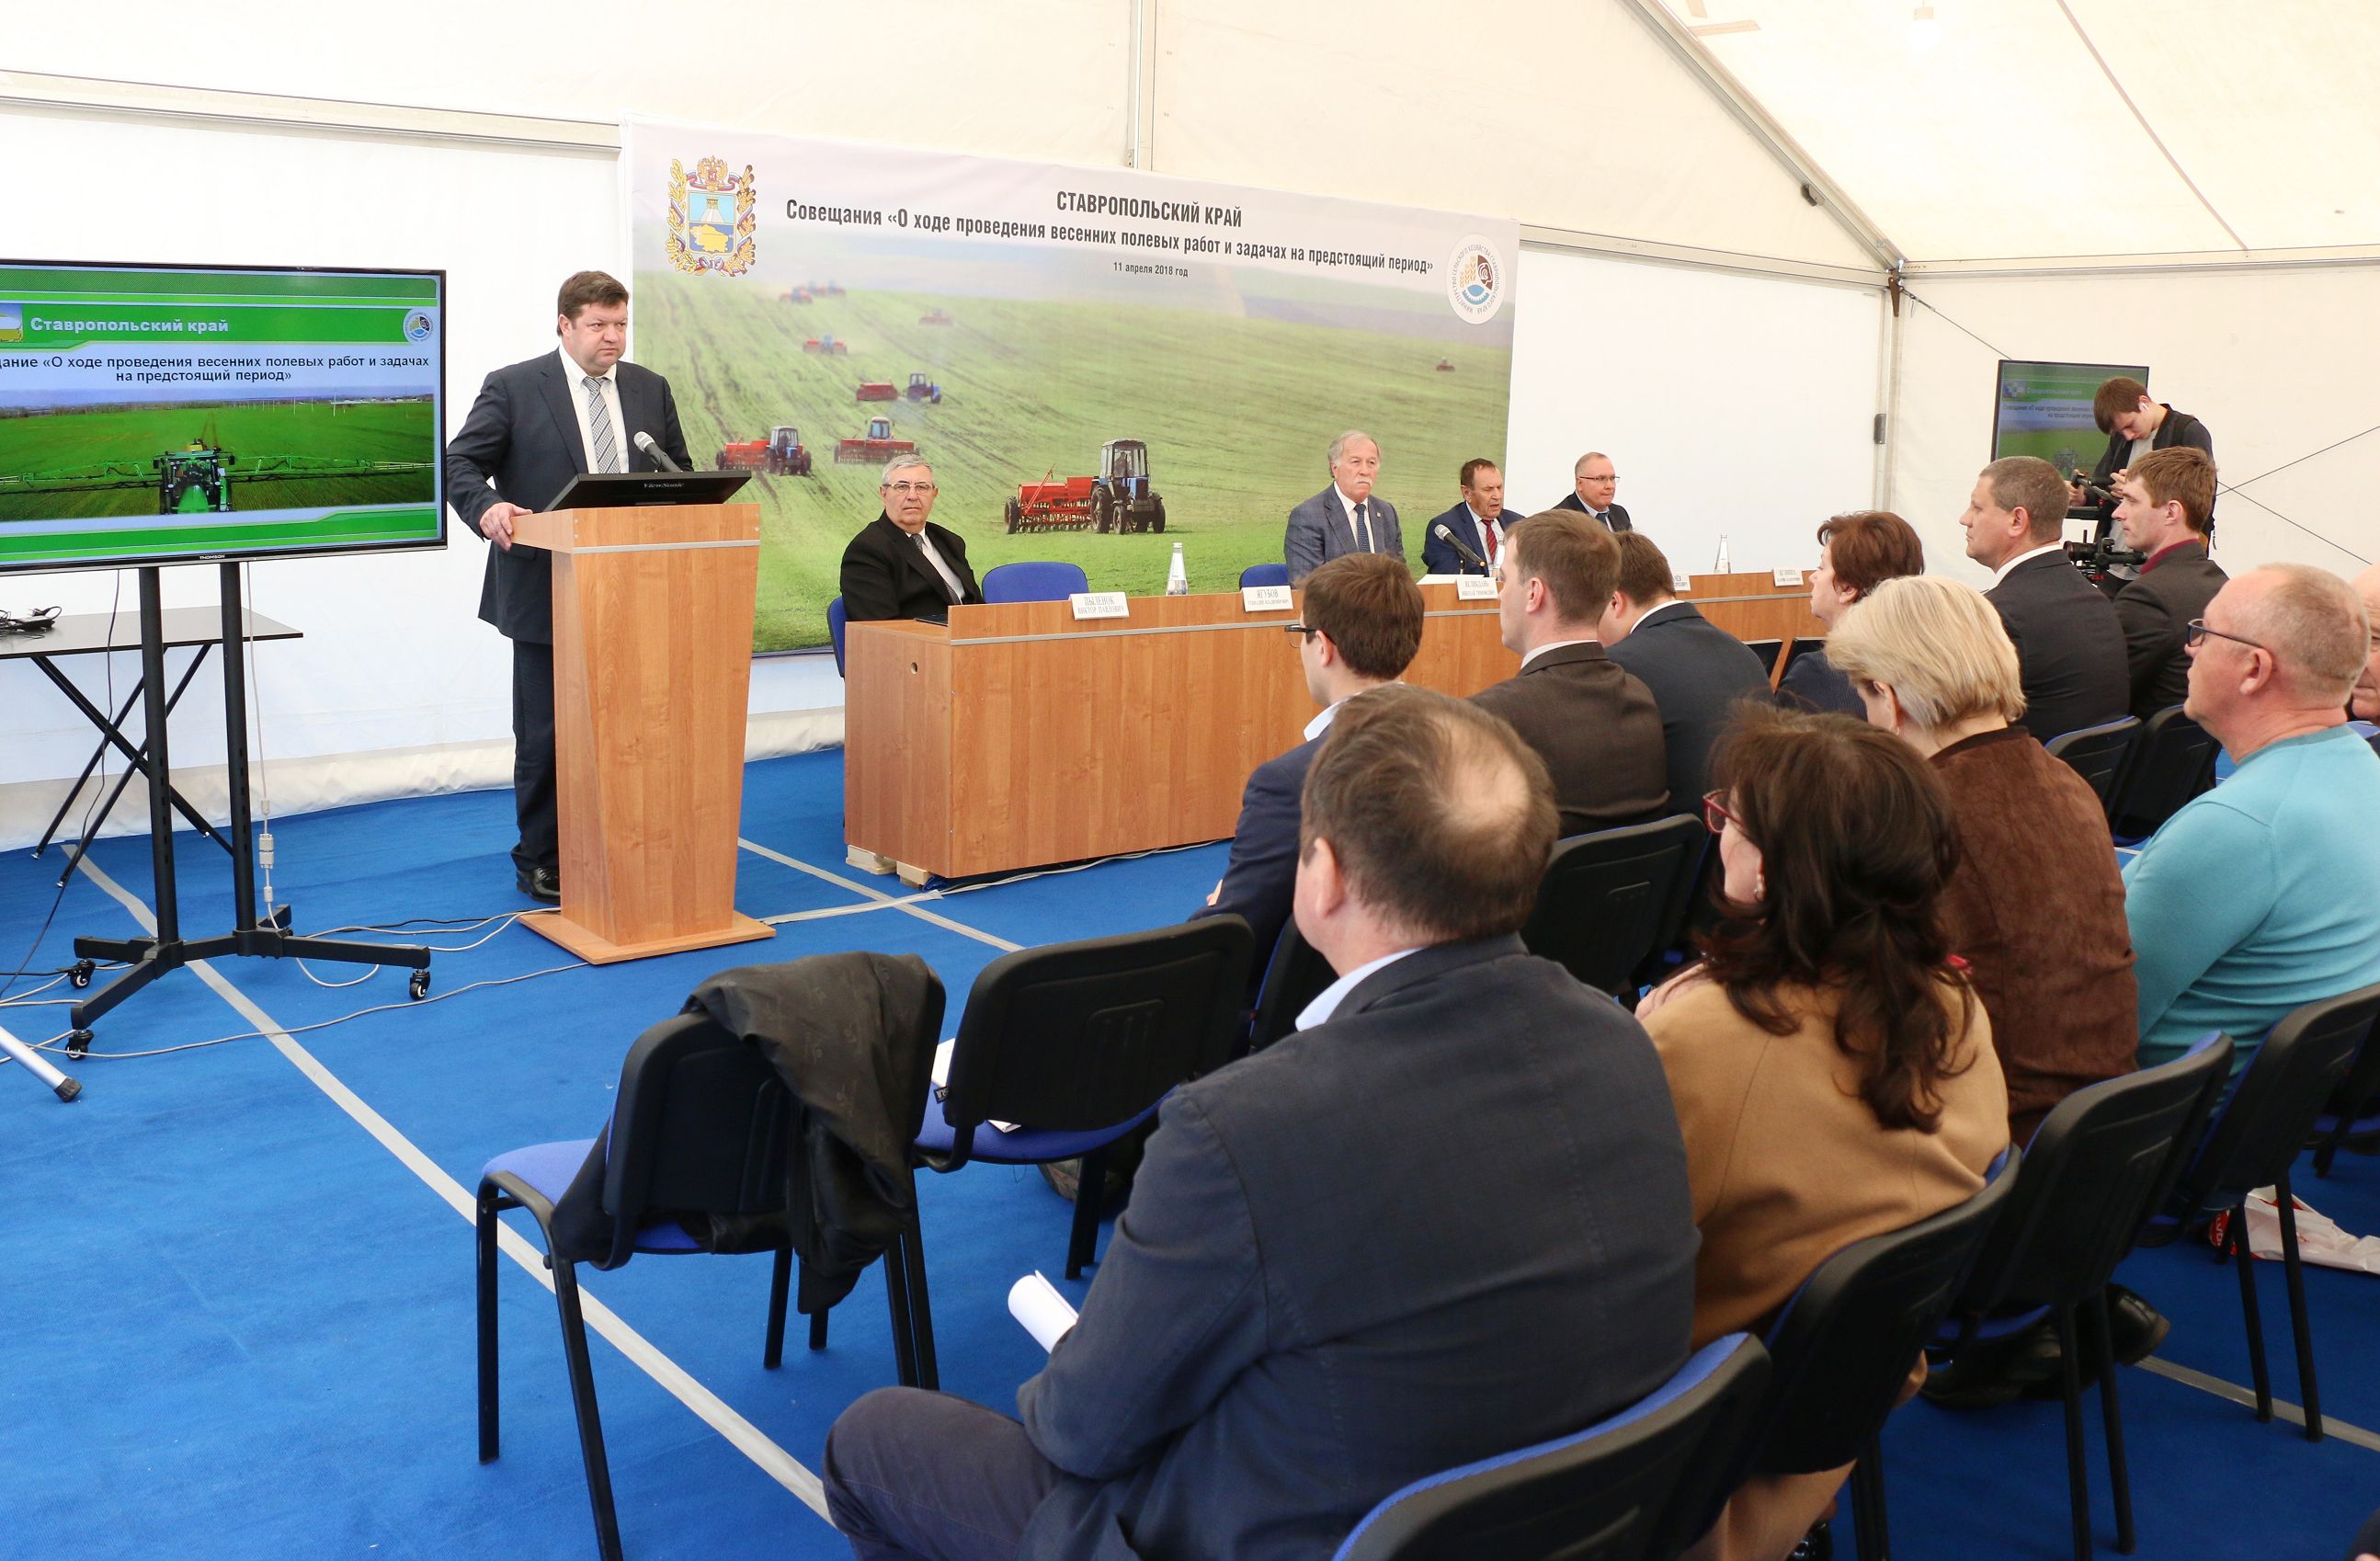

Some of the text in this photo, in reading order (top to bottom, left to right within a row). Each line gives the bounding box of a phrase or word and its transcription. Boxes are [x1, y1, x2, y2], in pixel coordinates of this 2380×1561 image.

[1056, 190, 1242, 228] СТАВРОПОЛЬСКИЙ КРАЙ
[786, 199, 1434, 275] Совещания «О ходе проведения весенних полевых работ и задачах на предстоящий период»
[1113, 261, 1189, 278] 11 апреля 2018 год
[30, 317, 229, 334] Ставропольский край
[0, 356, 429, 370] ание «О ходе проведения весенних полевых работ и задачах
[116, 369, 291, 383] на предстоящий период»
